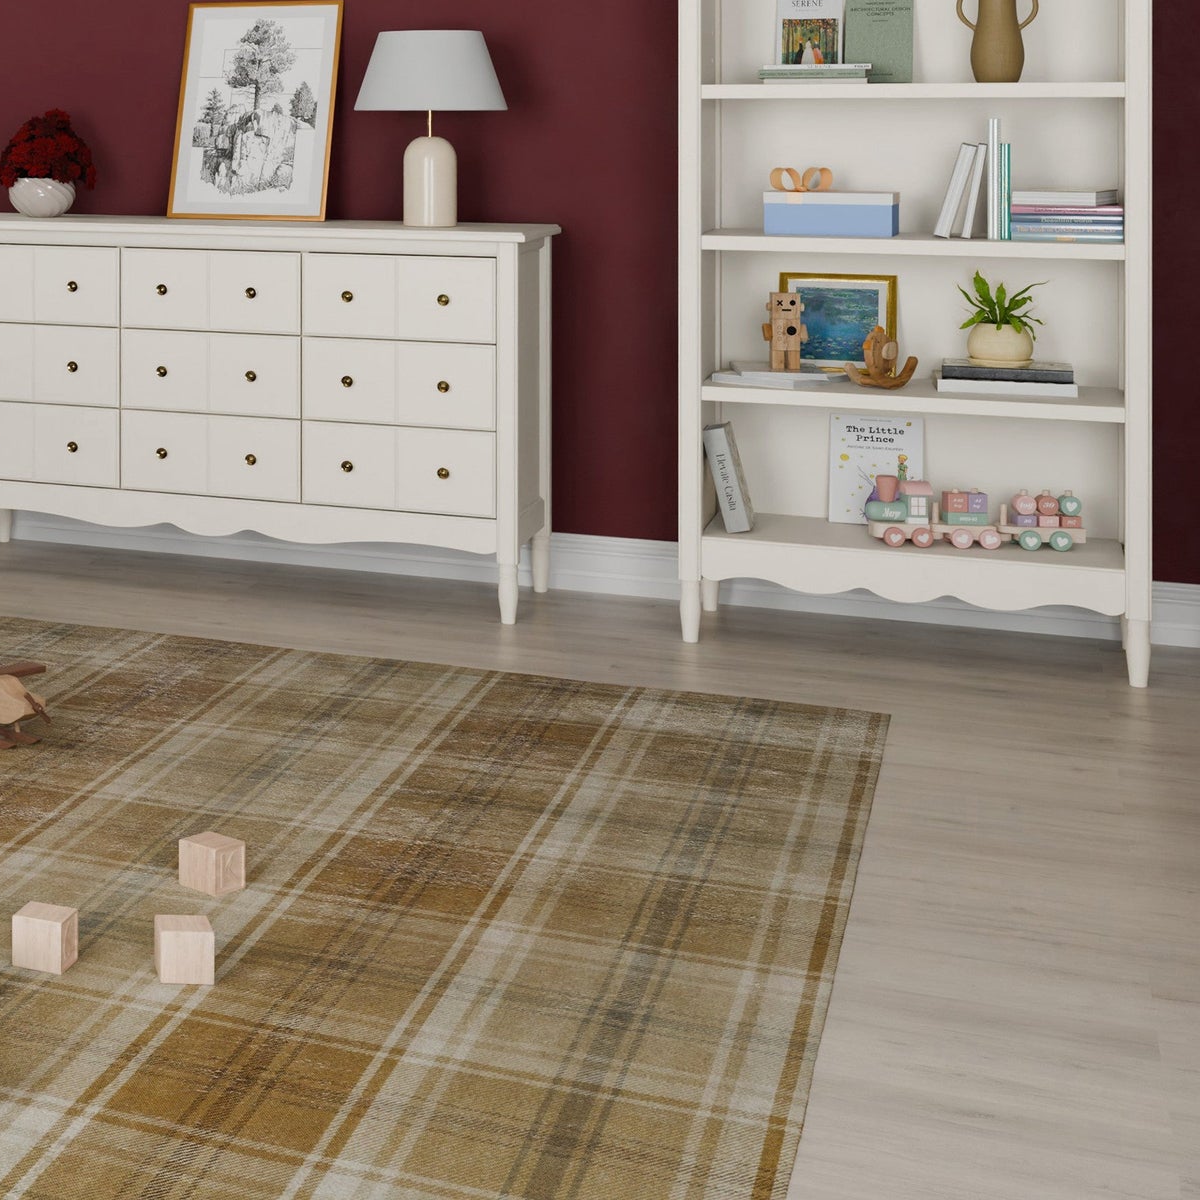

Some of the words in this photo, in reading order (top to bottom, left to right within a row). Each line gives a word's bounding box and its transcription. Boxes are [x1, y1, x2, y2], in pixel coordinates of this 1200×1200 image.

[791, 0, 824, 8] SERENE
[846, 425, 865, 433] The
[869, 426, 905, 435] Little
[856, 434, 895, 444] Prince
[724, 486, 736, 511] Casita
[219, 849, 240, 888] K
